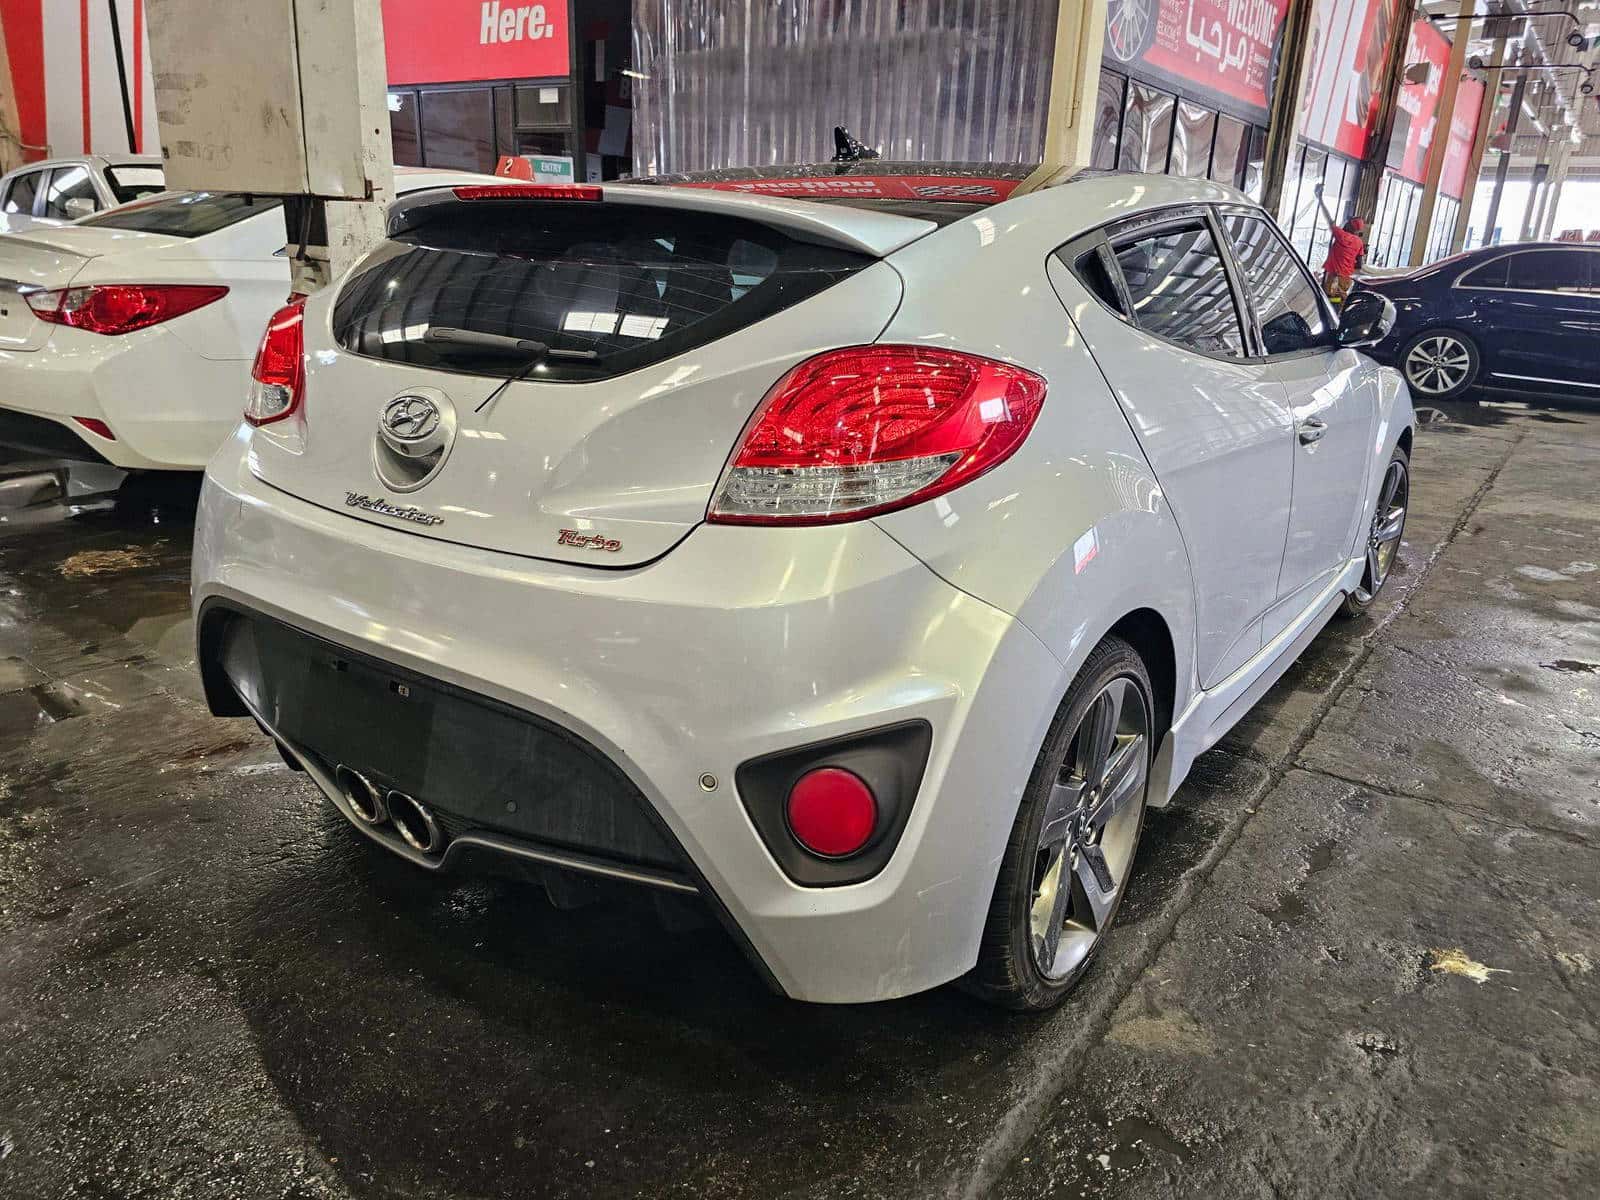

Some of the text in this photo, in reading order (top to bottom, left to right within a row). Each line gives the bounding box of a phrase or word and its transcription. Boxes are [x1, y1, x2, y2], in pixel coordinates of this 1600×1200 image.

[480, 0, 554, 44] Here.
[1186, 0, 1247, 73] مرحبا
[1227, 0, 1278, 48] WELCOME
[504, 158, 514, 175] 2
[541, 161, 562, 173] ENTRY
[345, 491, 444, 526] Veloster
[558, 529, 623, 551] Turbo
